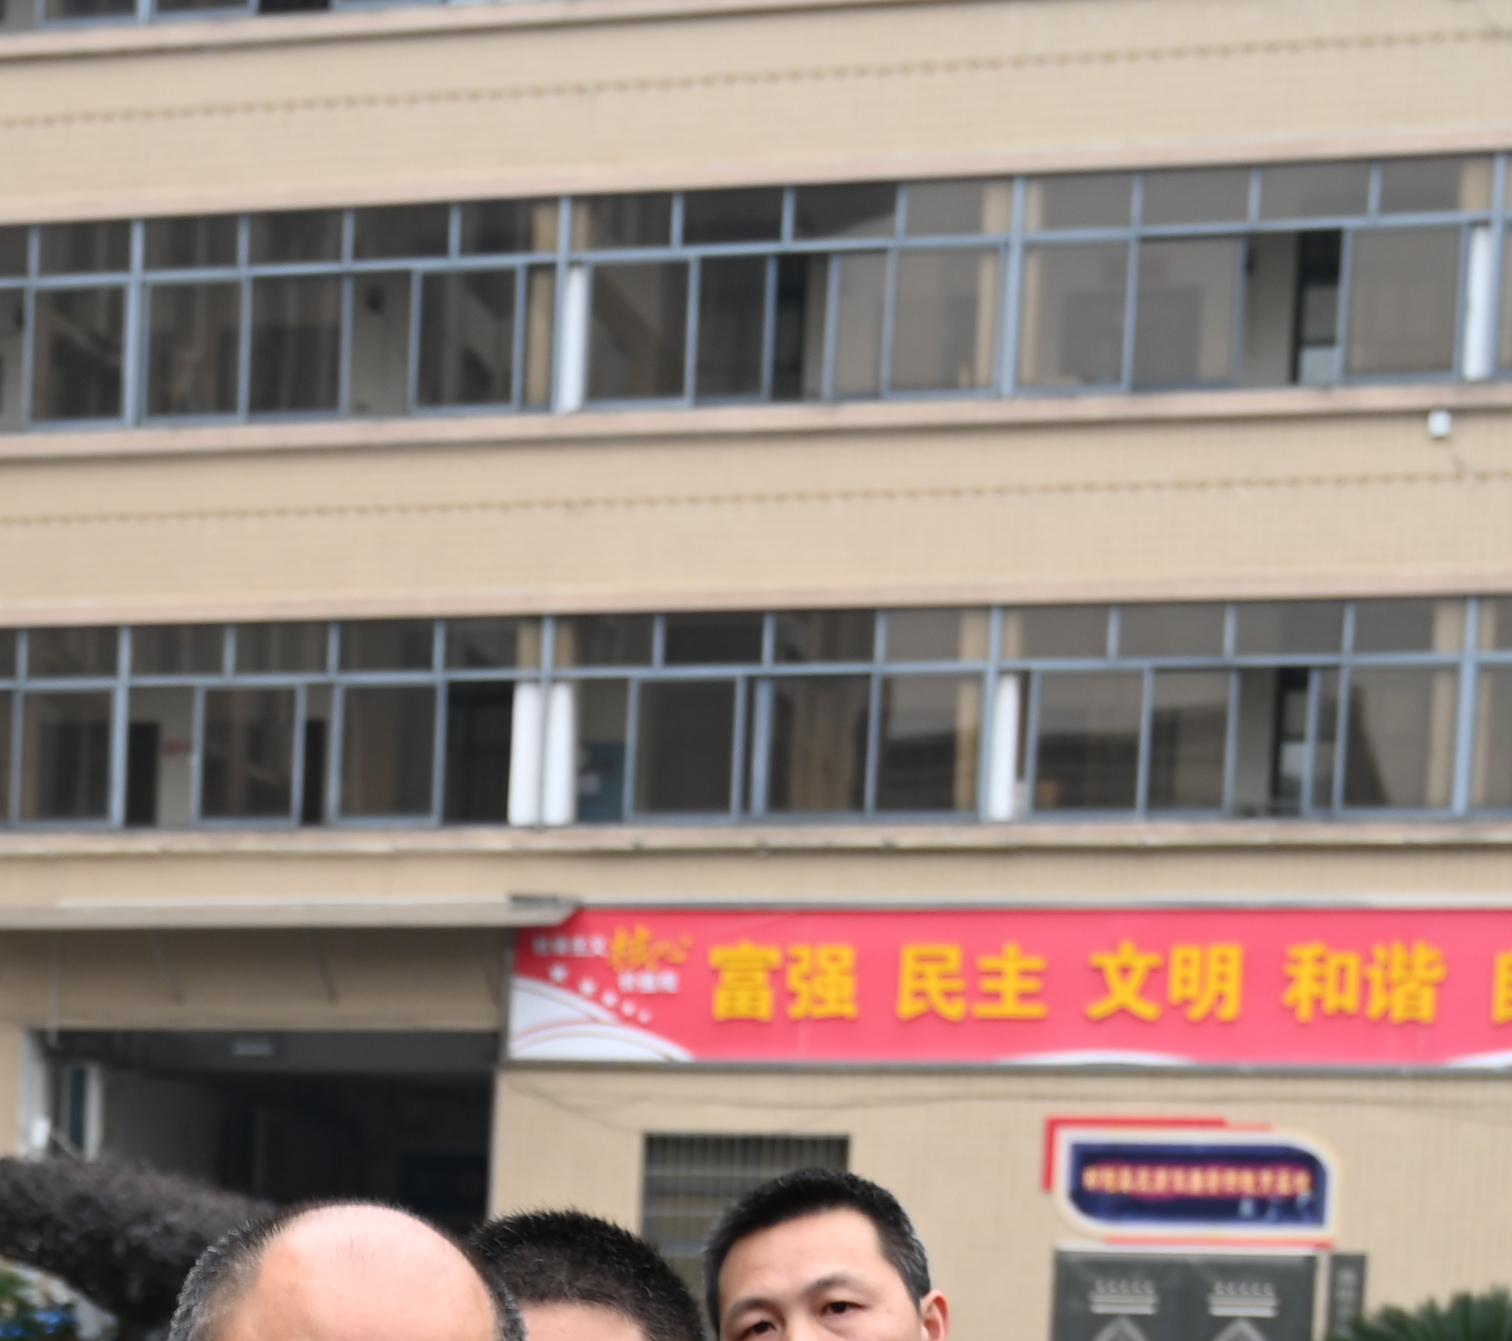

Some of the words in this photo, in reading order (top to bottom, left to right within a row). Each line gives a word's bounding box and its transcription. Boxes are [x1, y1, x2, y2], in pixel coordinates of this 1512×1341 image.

[708, 939, 858, 1022] 富强
[895, 942, 1048, 1022] 民主
[1085, 940, 1244, 1023] 文明
[1283, 940, 1447, 1025] 和谐
